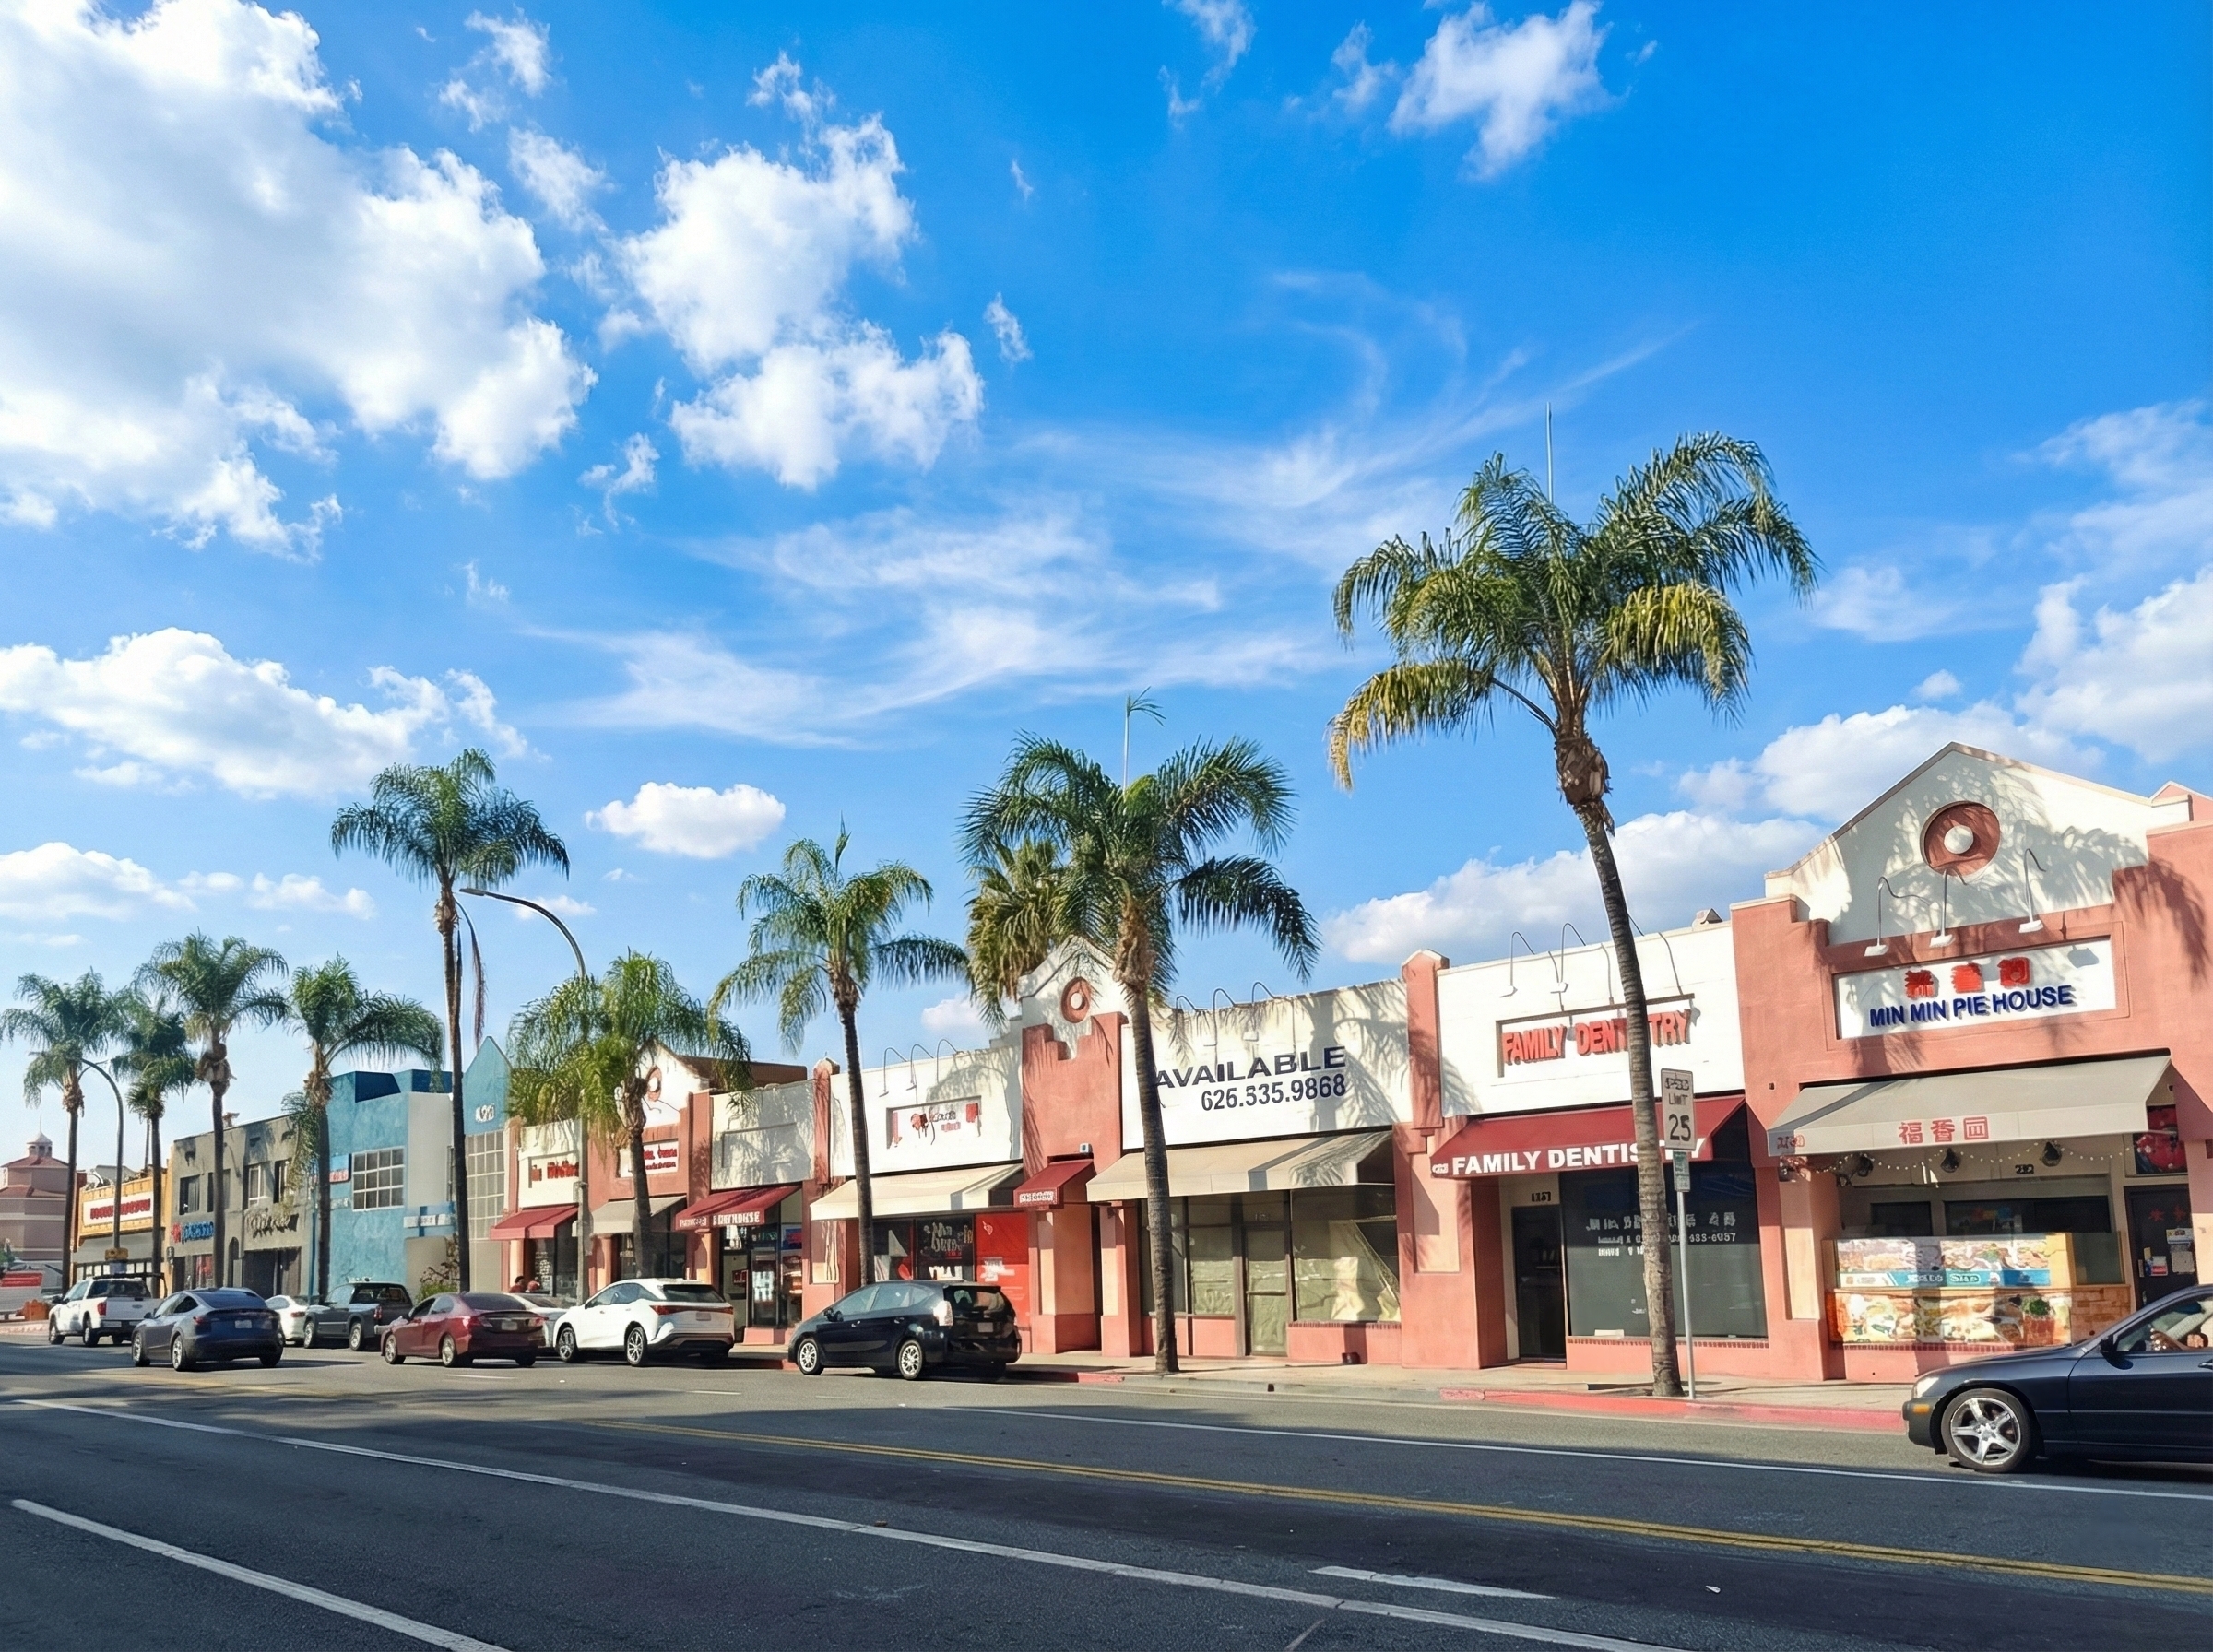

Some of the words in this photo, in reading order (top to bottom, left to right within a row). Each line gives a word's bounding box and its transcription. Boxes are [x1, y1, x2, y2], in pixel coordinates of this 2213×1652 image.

[1870, 1005, 1905, 1027] MIN
[1910, 999, 1947, 1022] MIN
[1952, 996, 1988, 1018] PIE
[1992, 985, 2074, 1013] HOUSE
[1501, 1025, 1566, 1065] FAMILY
[1575, 1009, 1691, 1056] DENTTRY
[1154, 1045, 1346, 1089] AVAILABLE
[1201, 1073, 1346, 1111] 626.535.9868
[1668, 1114, 1691, 1141] 25
[1452, 1150, 1542, 1175] FAMILY
[1547, 1138, 1706, 1169] DENTISY
